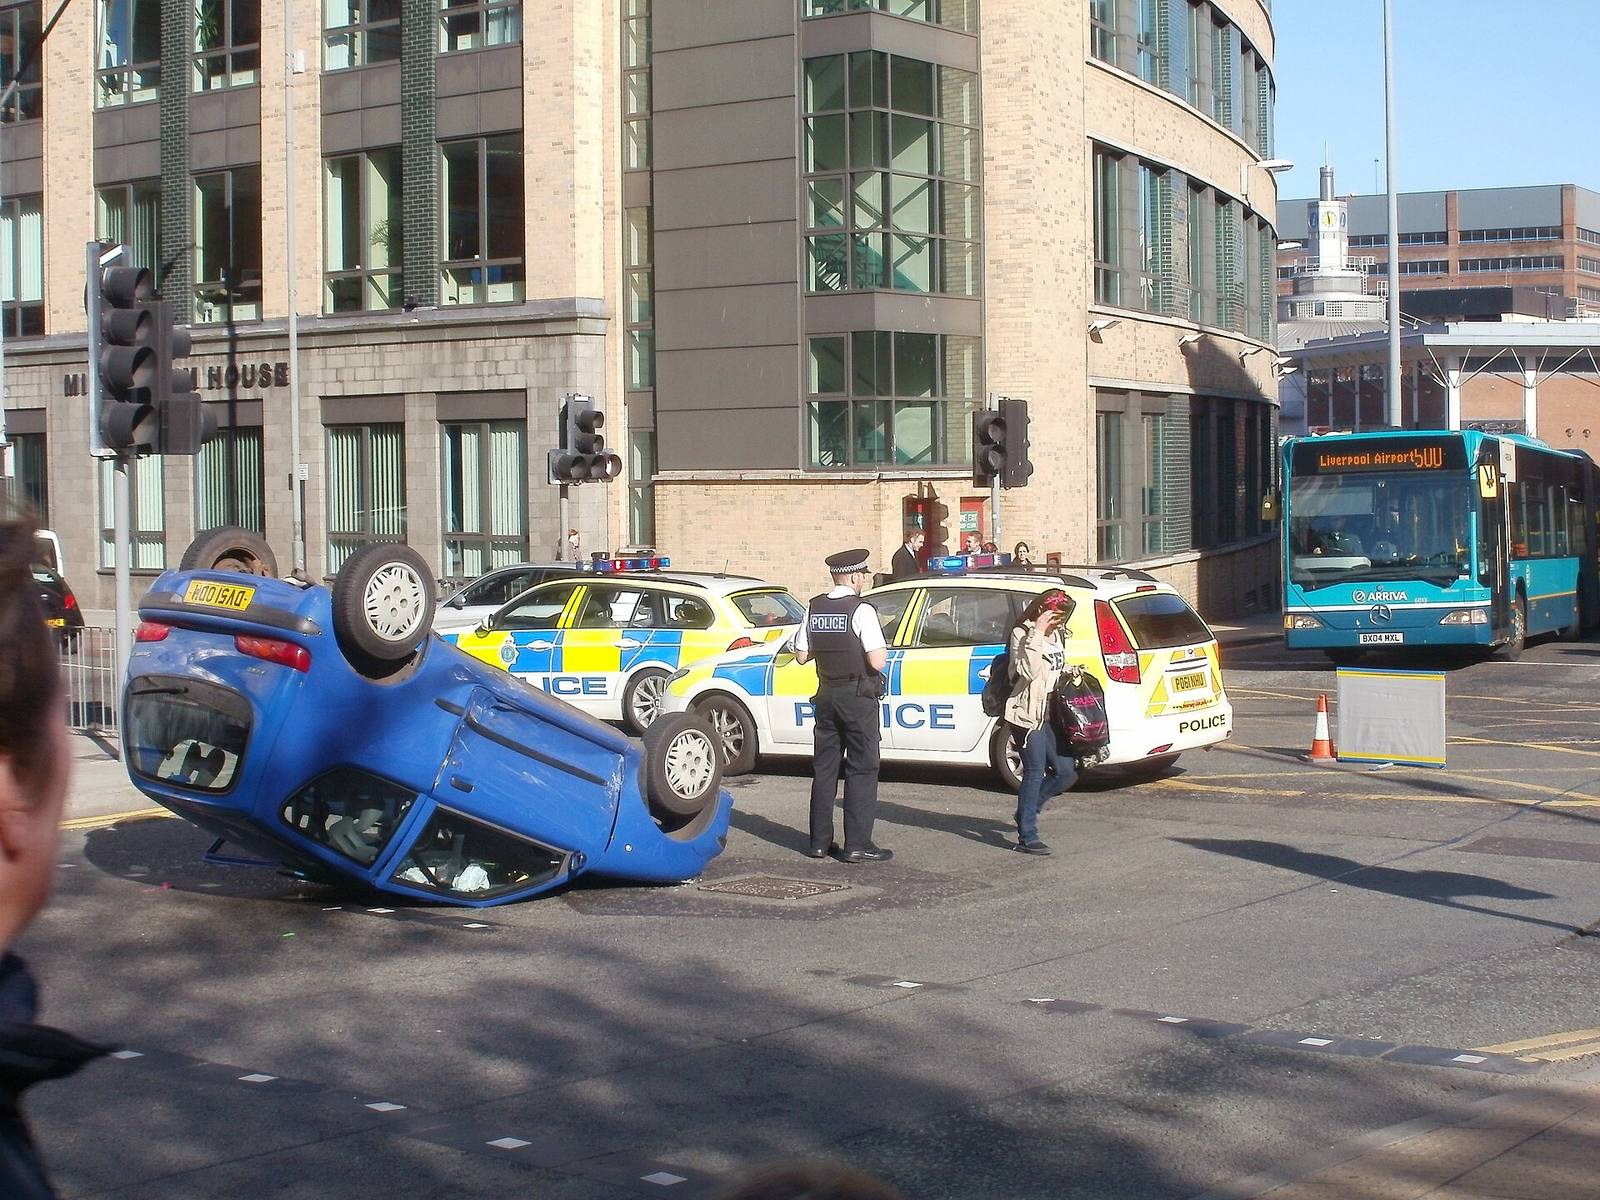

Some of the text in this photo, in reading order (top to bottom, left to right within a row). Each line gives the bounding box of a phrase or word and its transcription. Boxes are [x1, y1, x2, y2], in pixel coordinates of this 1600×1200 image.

[207, 362, 290, 390] HOUSE
[1319, 452, 1370, 467] Liverpool
[1374, 451, 1414, 465] Airport
[1367, 591, 1408, 602] ARRIVA
[811, 616, 846, 631] POLICE
[1362, 633, 1401, 643] BX04 HXL
[519, 676, 608, 696] ICE
[794, 702, 956, 730] PICE
[1179, 713, 1226, 733] POLICE
